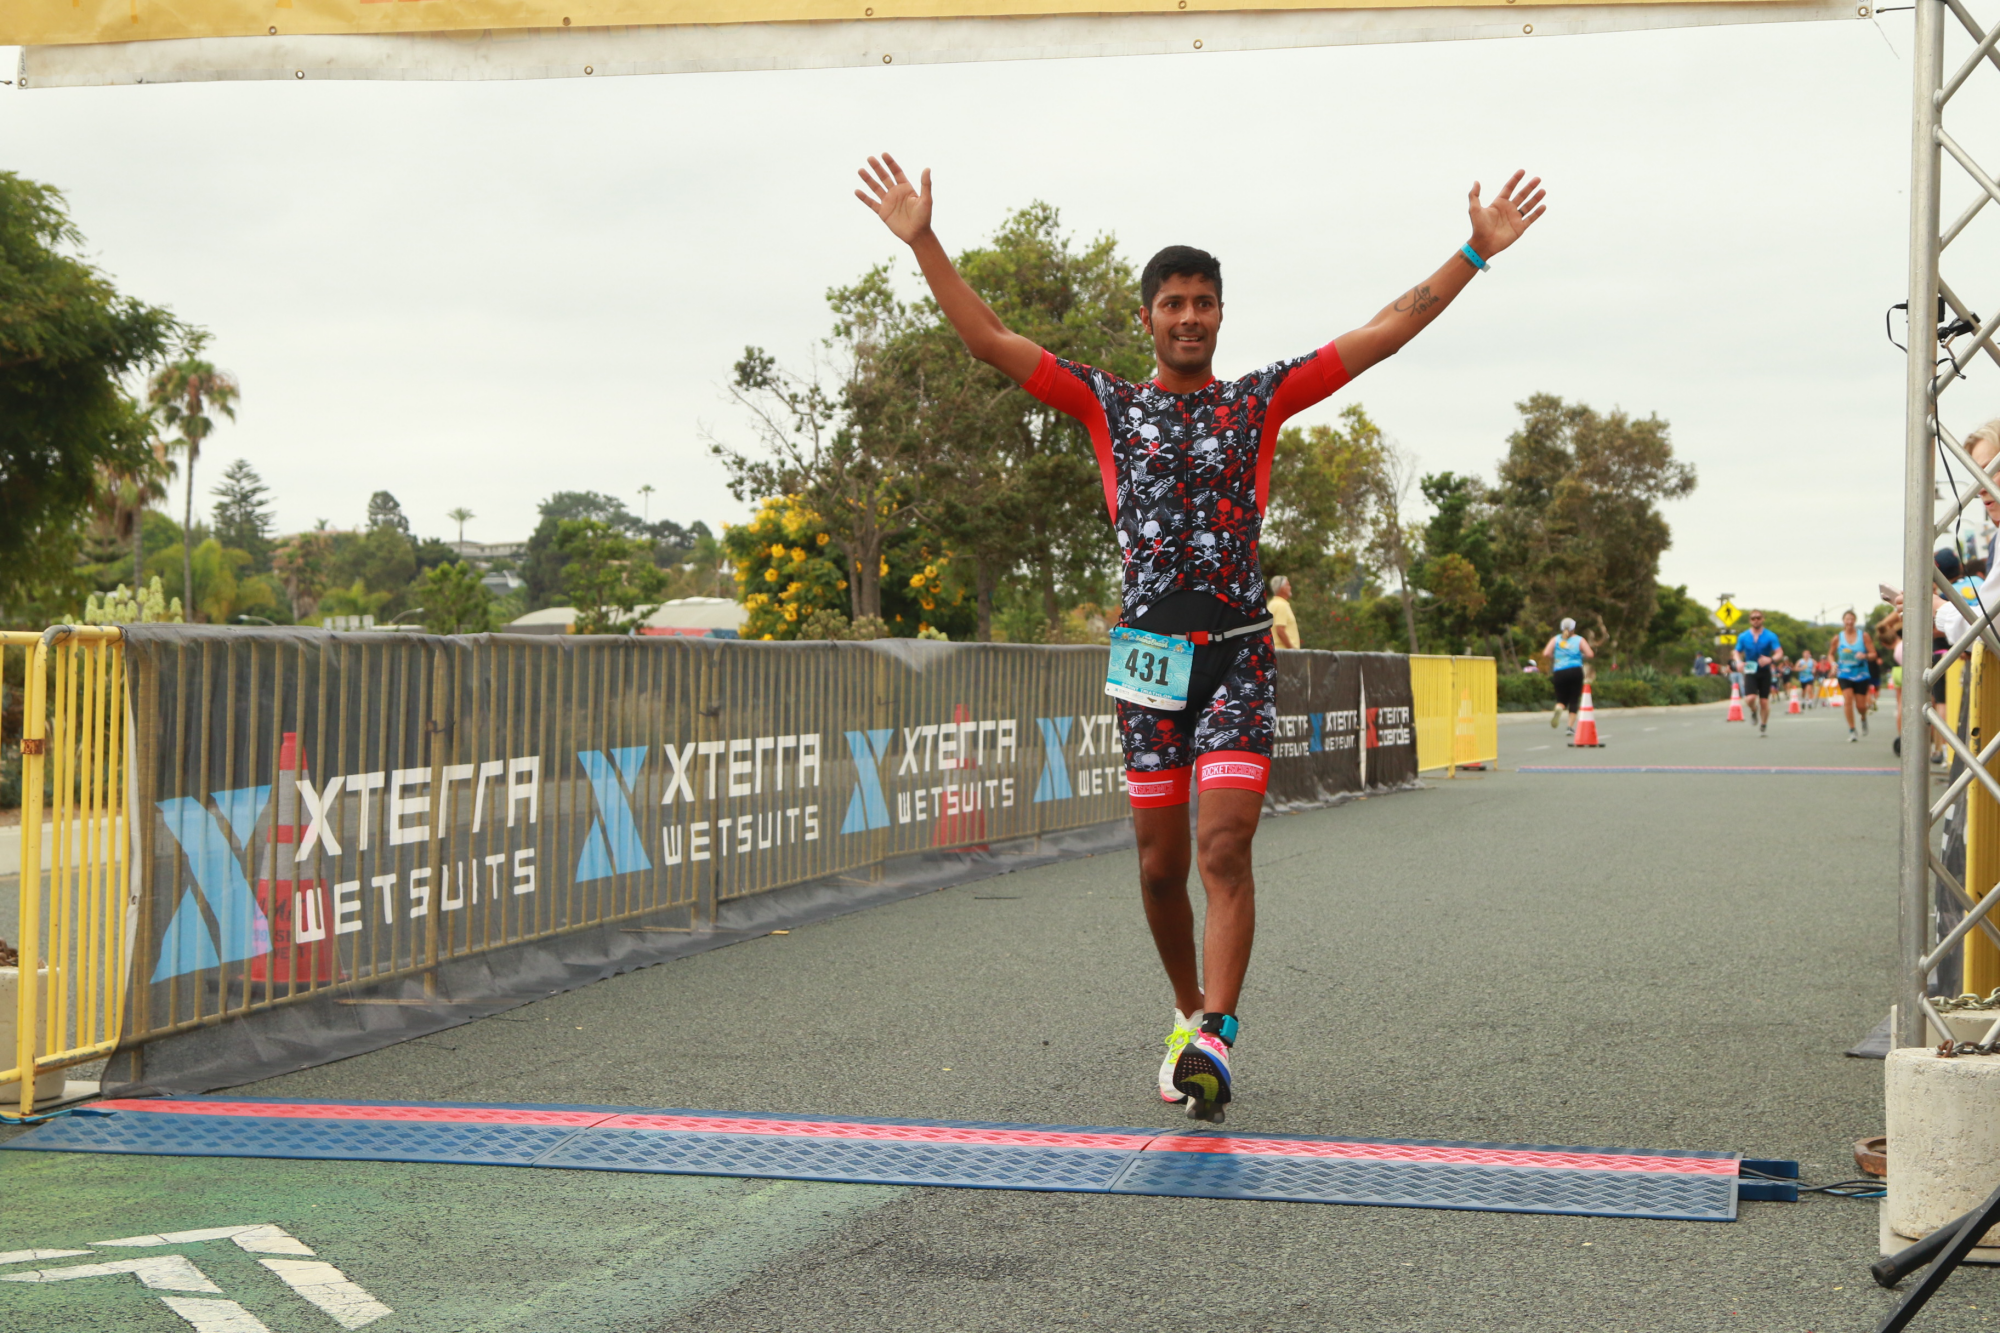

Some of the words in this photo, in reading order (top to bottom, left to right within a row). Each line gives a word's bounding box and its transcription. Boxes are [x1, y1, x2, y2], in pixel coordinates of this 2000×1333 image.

[1125, 648, 1169, 686] 431
[661, 733, 820, 805] XTERRA
[898, 719, 1017, 776] XTERRA
[294, 756, 540, 862] XTERRA
[898, 777, 1014, 824] WETSUITS
[1079, 765, 1128, 797] WETS
[662, 805, 819, 866] WETSUITS
[295, 848, 536, 944] WETSUITS
